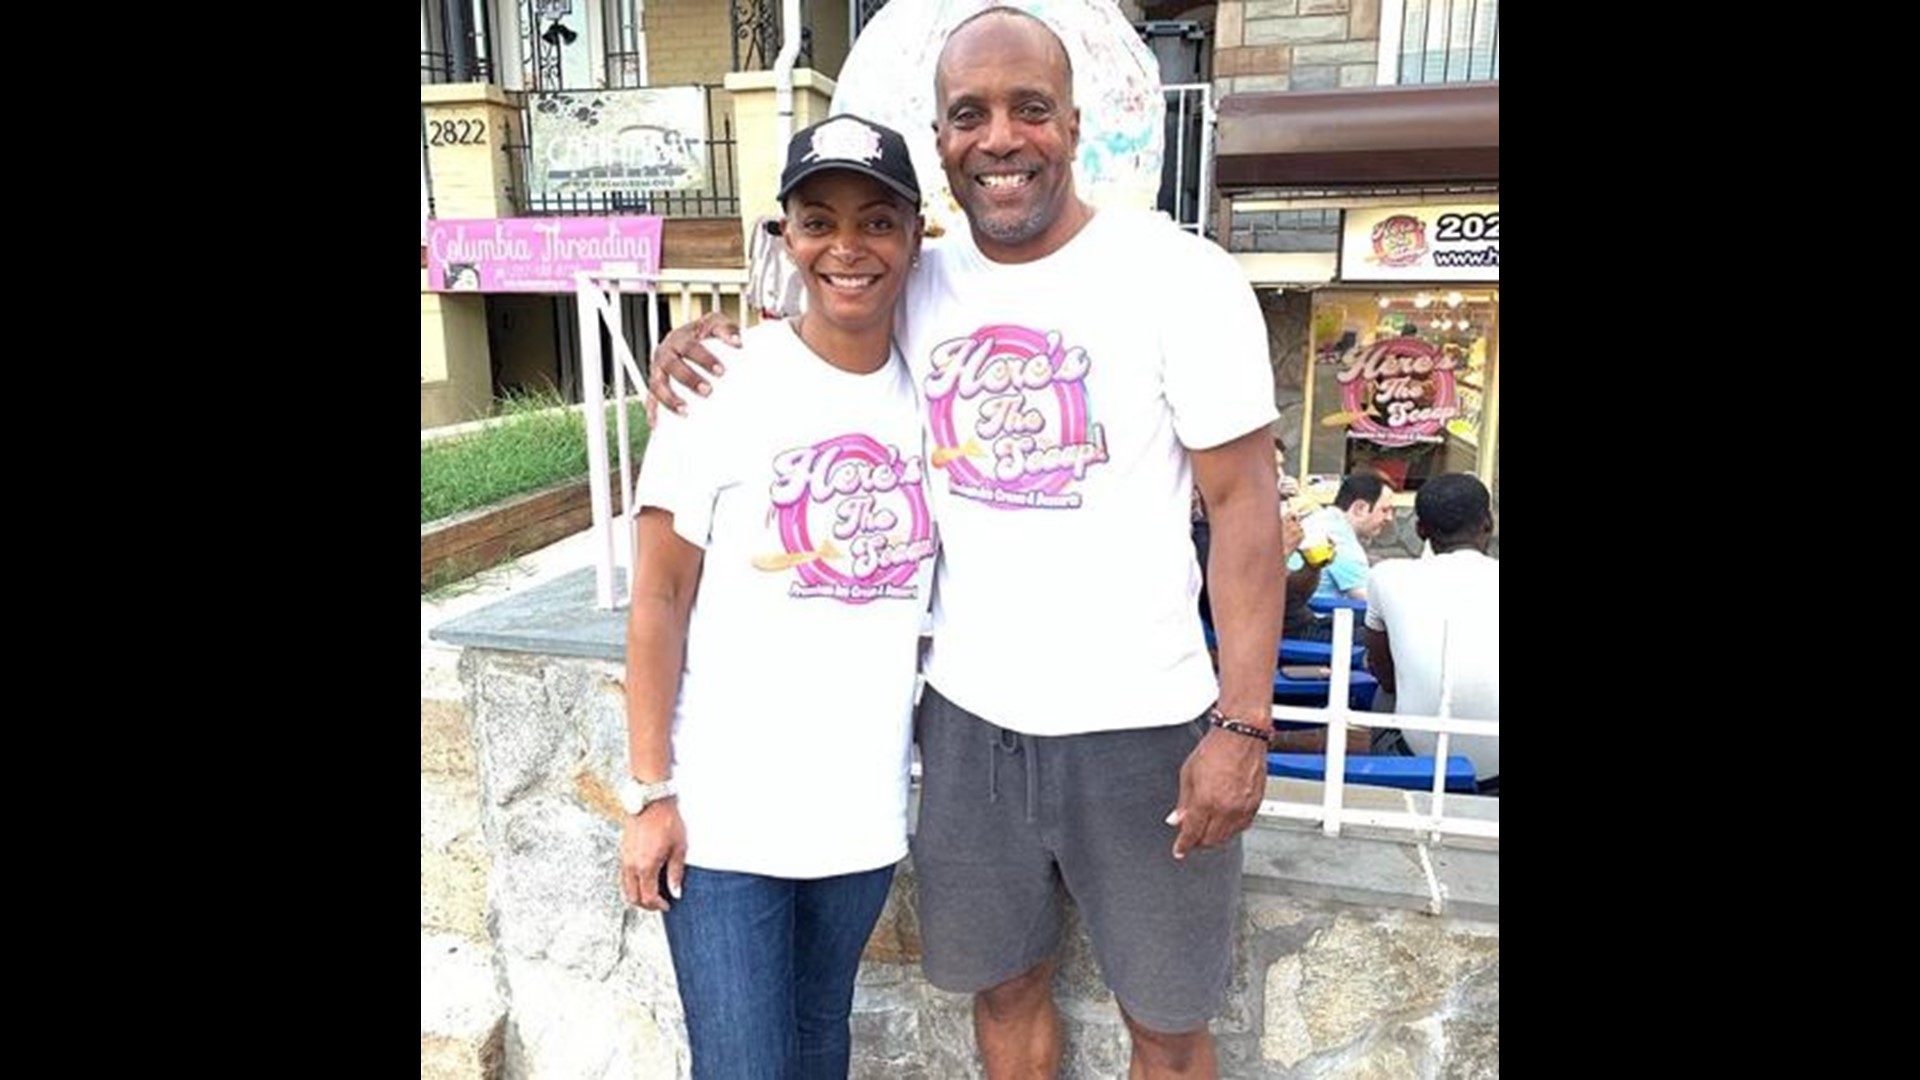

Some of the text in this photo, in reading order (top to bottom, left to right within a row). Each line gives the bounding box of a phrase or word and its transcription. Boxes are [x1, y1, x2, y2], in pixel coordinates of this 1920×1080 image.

[429, 119, 486, 146] 2822
[432, 222, 651, 276] Columbia Threading
[925, 329, 1091, 400] Here's
[1375, 376, 1424, 403] The
[975, 394, 1046, 440] The
[993, 423, 1109, 482] Scoop!
[833, 494, 898, 540] The
